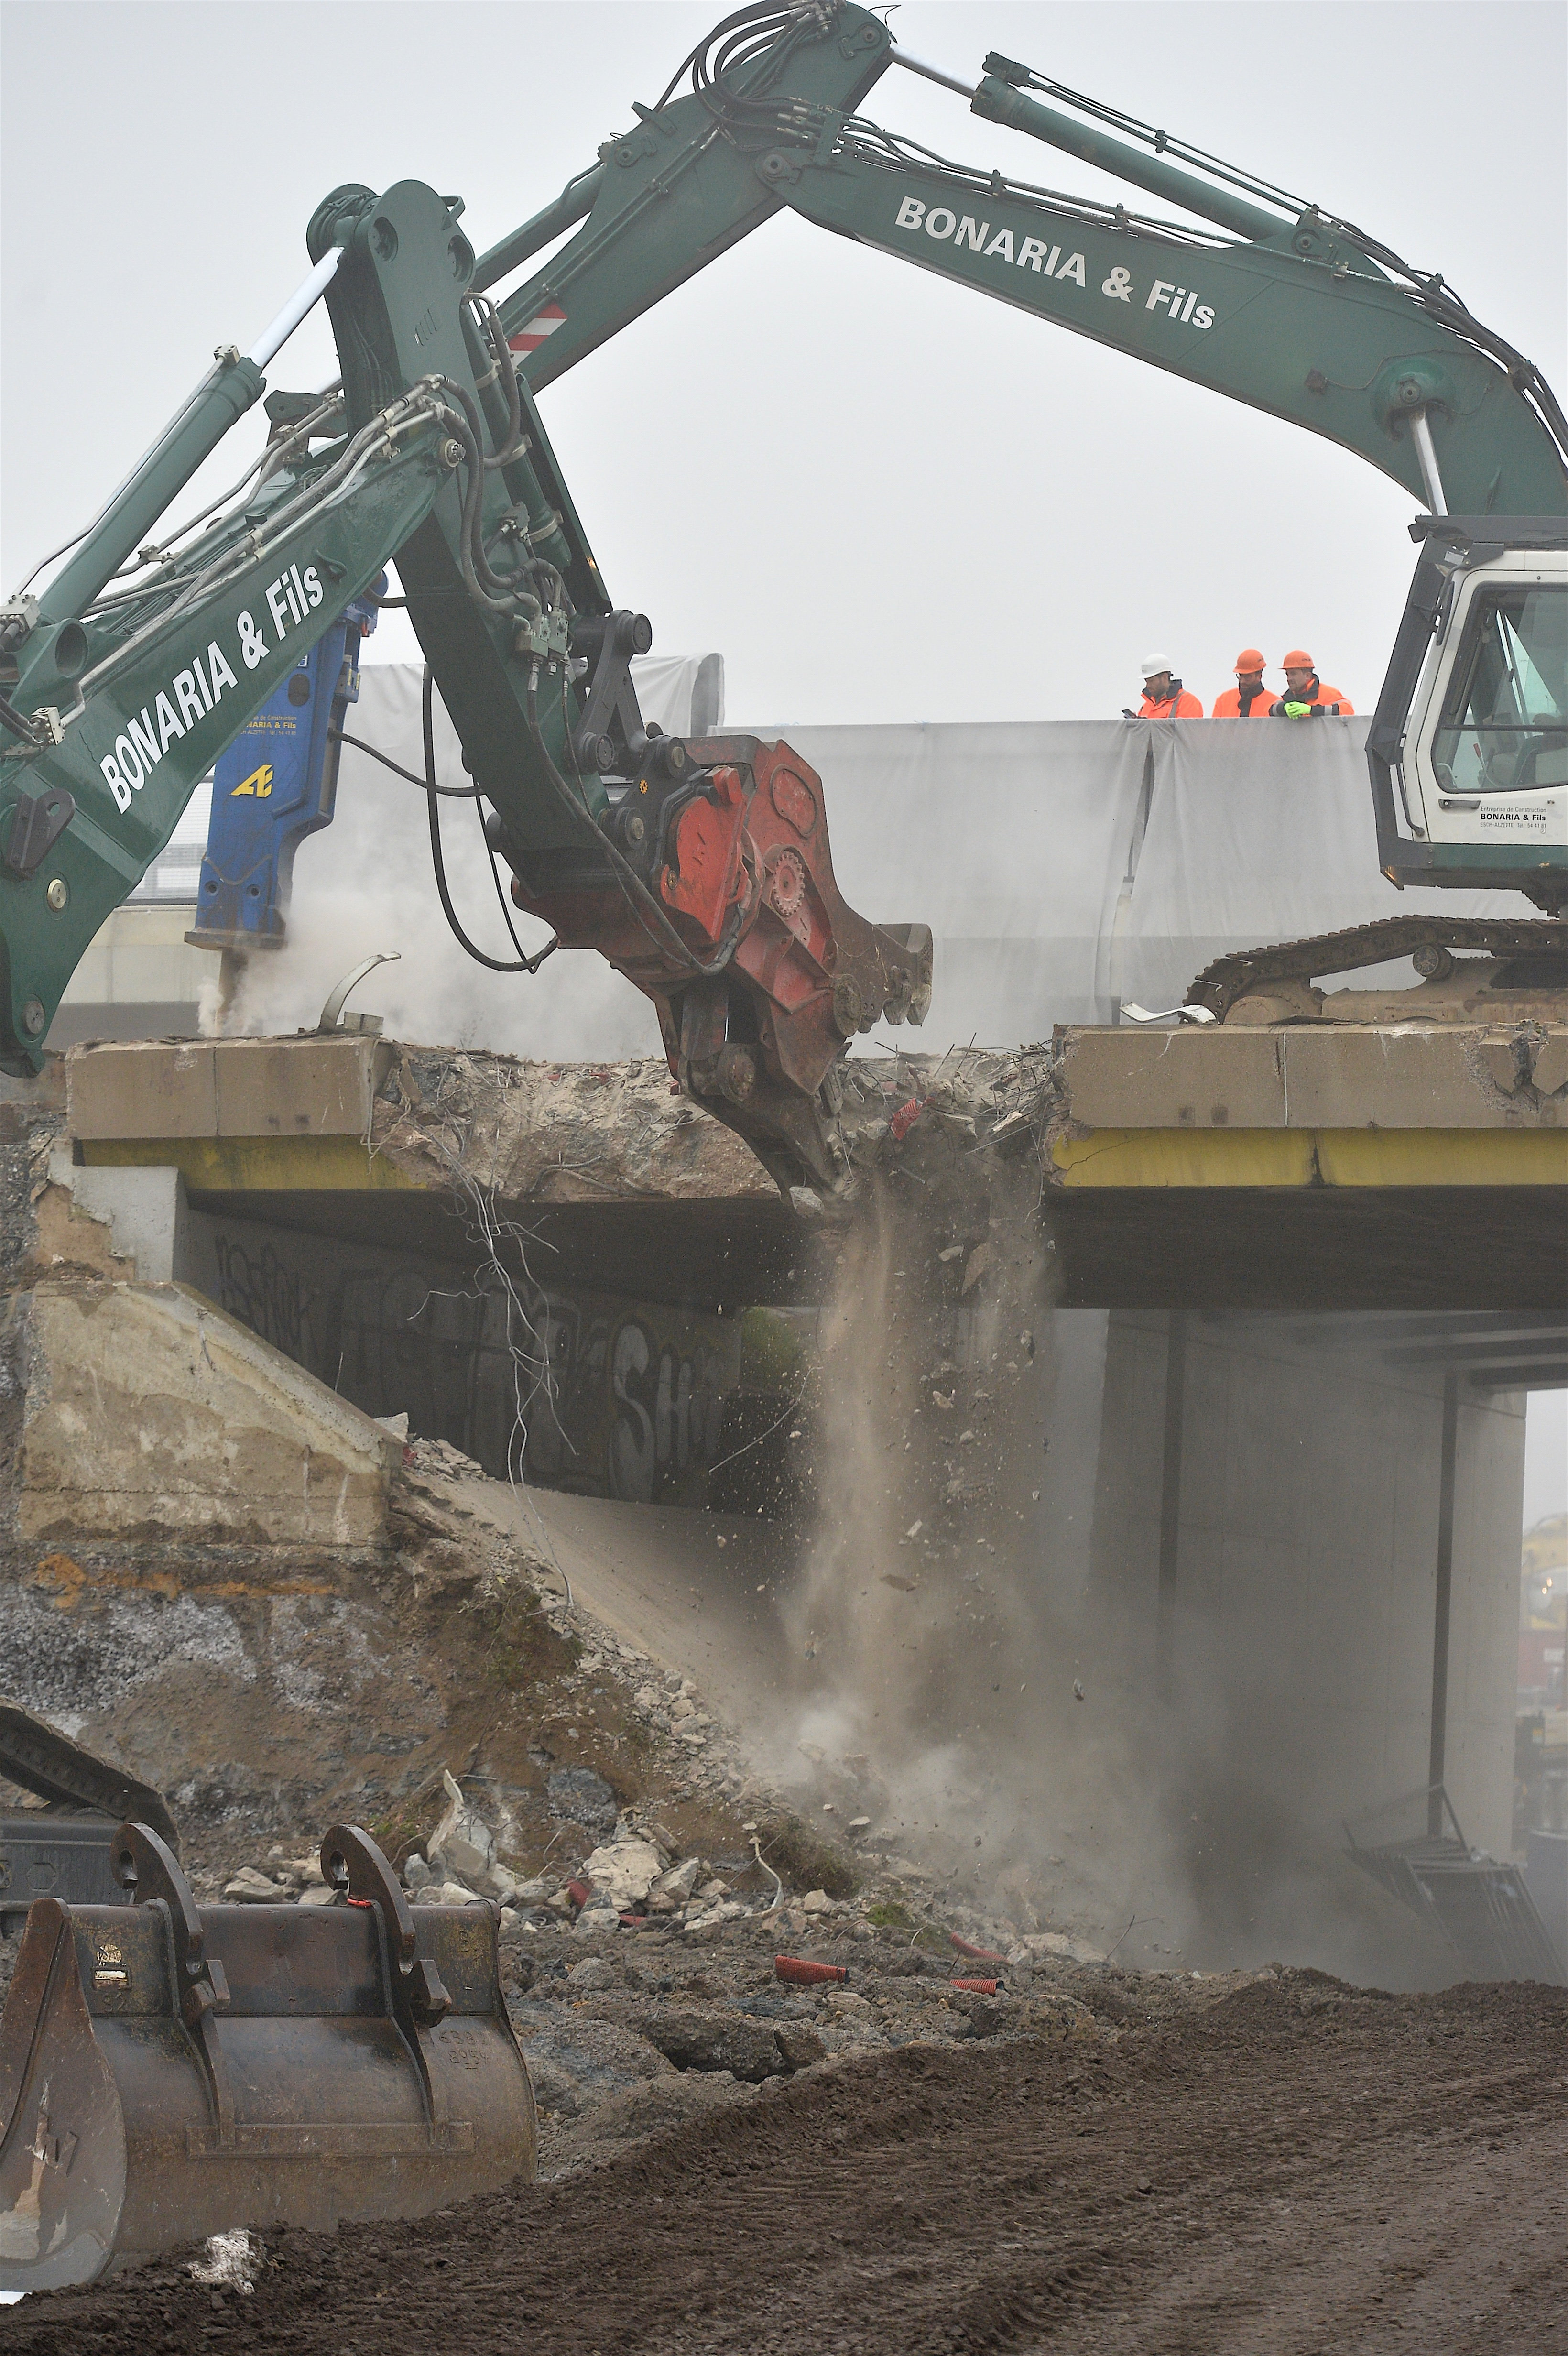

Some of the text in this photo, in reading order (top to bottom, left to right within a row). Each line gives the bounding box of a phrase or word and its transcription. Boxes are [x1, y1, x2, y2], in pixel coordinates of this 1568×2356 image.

[895, 196, 1215, 330] BONARIA & Fils
[99, 563, 324, 814] BONARIA & Fils
